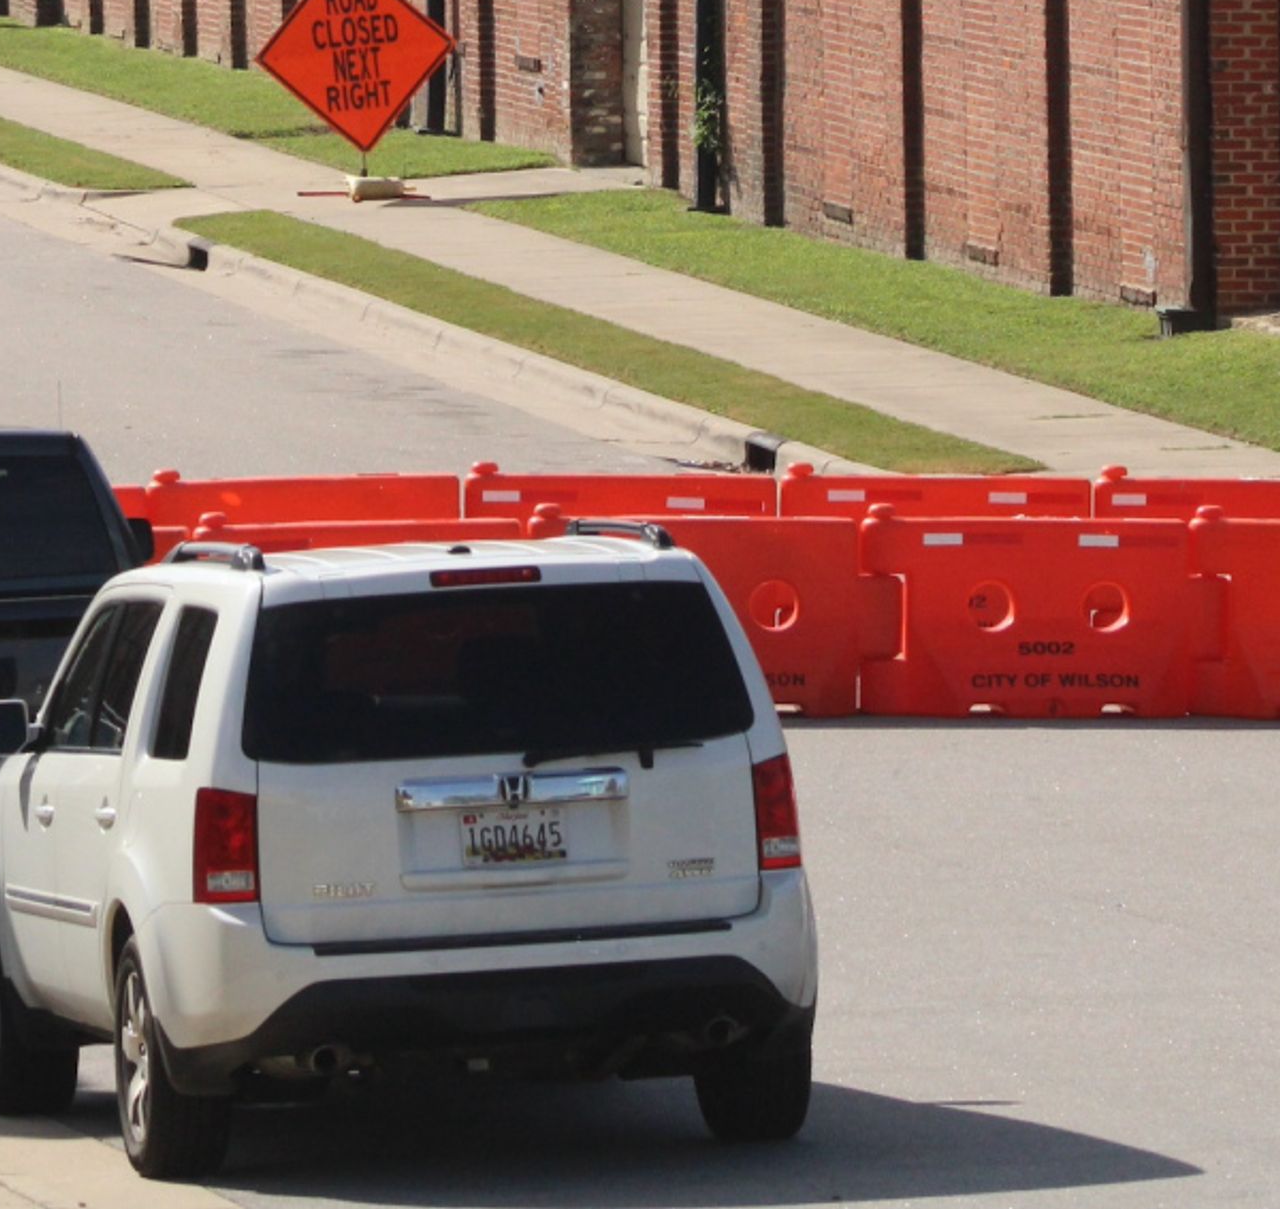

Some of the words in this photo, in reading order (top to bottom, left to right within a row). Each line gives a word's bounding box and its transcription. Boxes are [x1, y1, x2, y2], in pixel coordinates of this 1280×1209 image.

[312, 14, 398, 50] CLOSED
[333, 47, 380, 83] NEXT
[326, 80, 391, 112] RIGHT
[1019, 640, 1075, 656] 5002
[971, 673, 1017, 689] CITY
[1024, 673, 1053, 688] OF
[1059, 673, 1139, 689] WILSON
